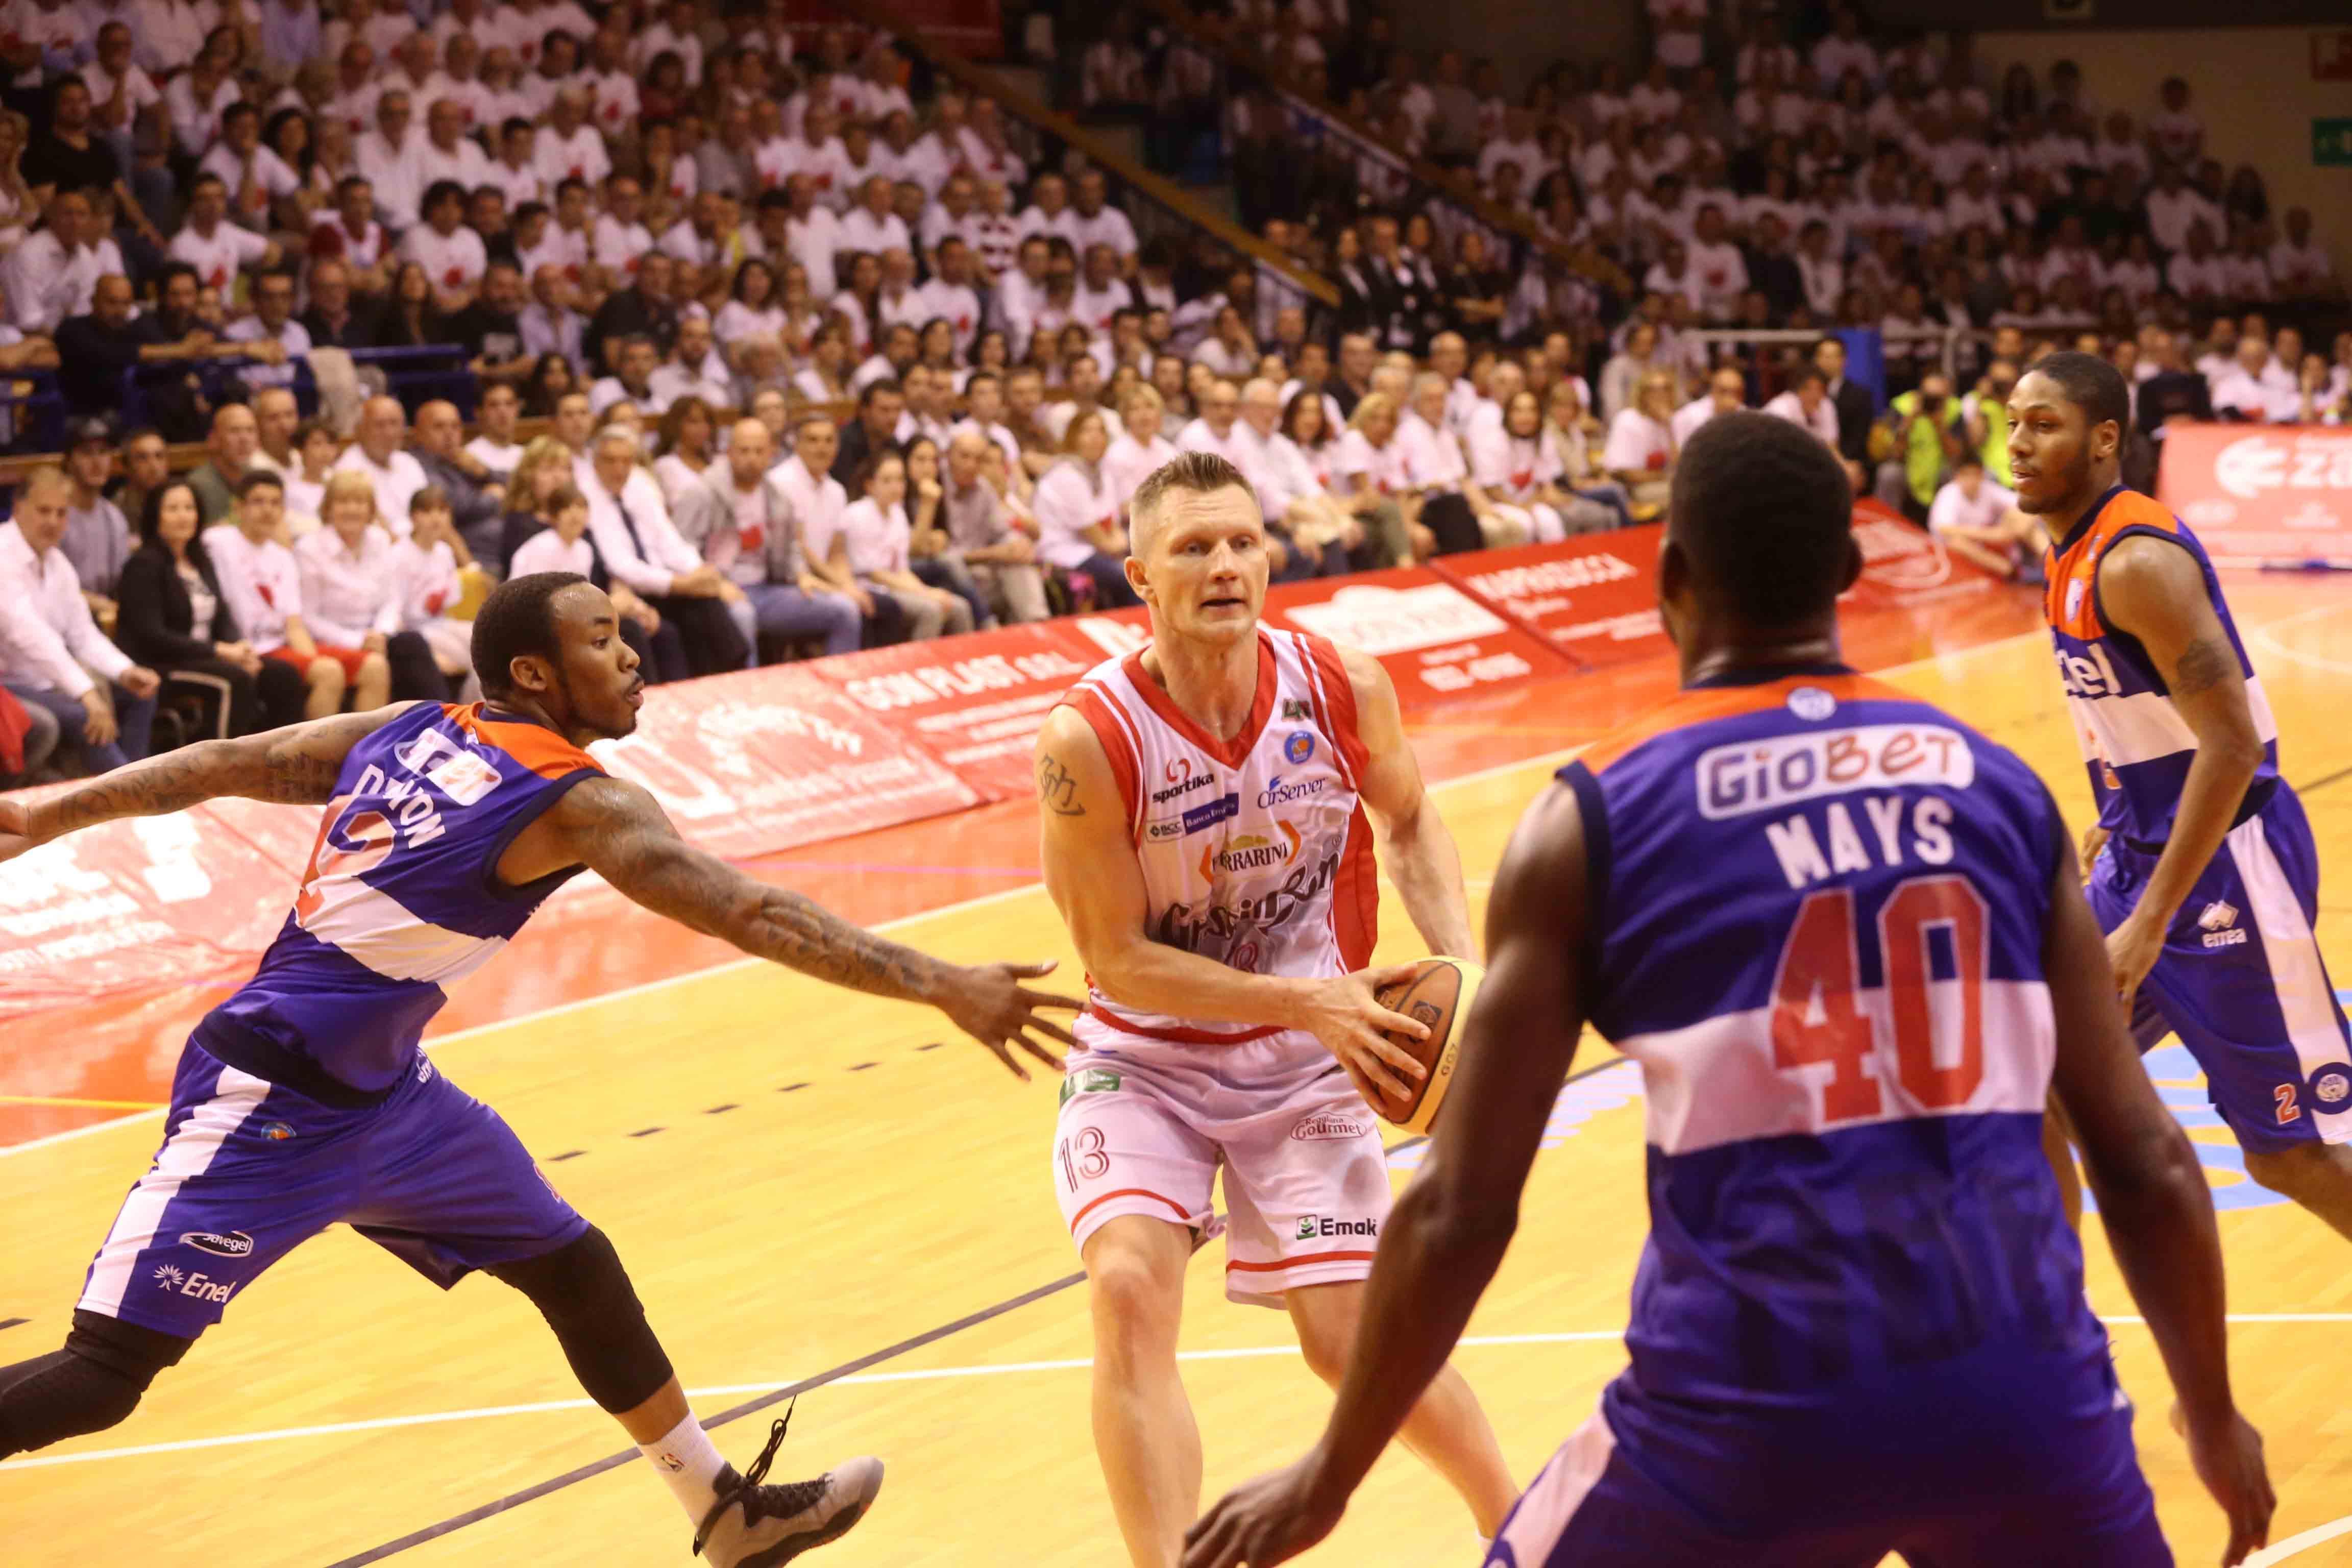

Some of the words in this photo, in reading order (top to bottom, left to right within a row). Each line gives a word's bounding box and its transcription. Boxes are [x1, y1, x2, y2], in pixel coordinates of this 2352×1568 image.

[2054, 642, 2122, 695] nel
[1153, 773, 1214, 803] sportika
[1257, 777, 1327, 808] CirServer
[1161, 821, 1183, 836] BCC
[1765, 796, 1955, 889] MAYS
[1769, 874, 1991, 1127] 40
[2274, 1083, 2301, 1124] 2
[1296, 1122, 1362, 1139] Gourmet
[1058, 1126, 1110, 1193] 13
[1320, 1218, 1377, 1236] Emak
[180, 1272, 237, 1303] Enel
